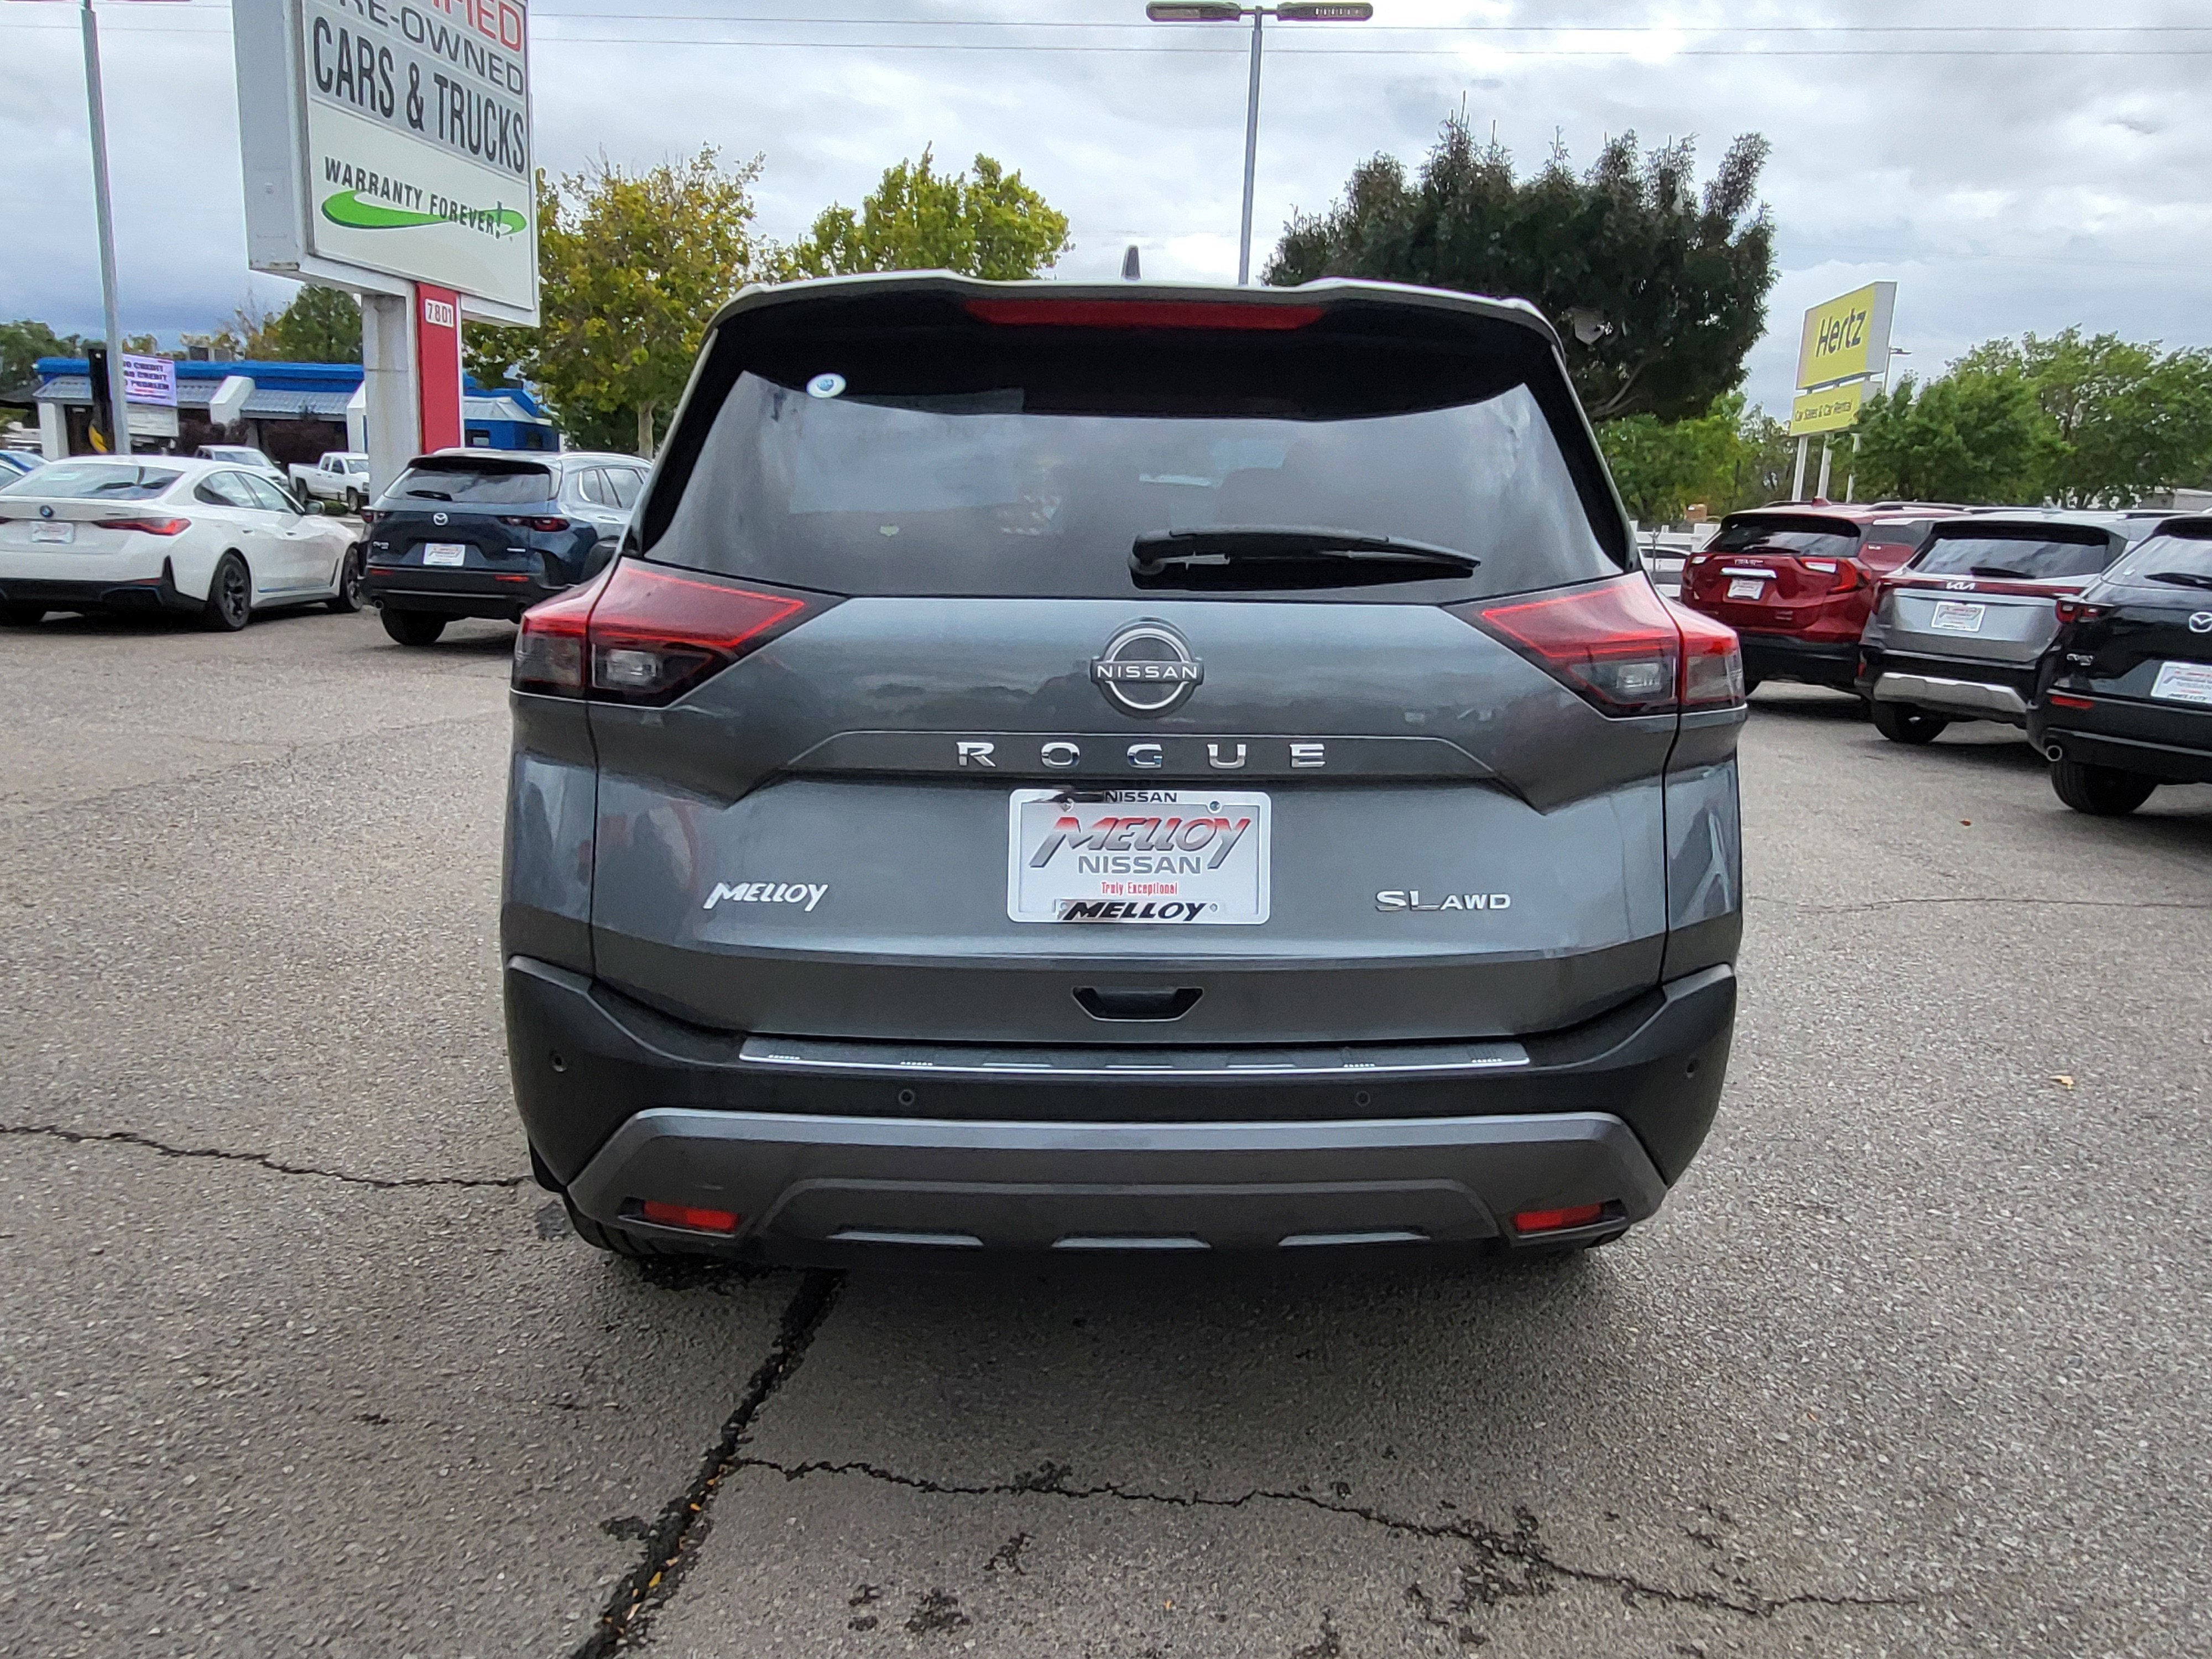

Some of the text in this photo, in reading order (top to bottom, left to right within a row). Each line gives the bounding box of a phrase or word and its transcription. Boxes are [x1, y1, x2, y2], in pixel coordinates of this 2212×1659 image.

[314, 17, 525, 174] CARS & TRUCKS
[325, 156, 423, 210] WARRANTY
[427, 302, 452, 324] 7801
[1815, 307, 1866, 358] Hertz
[1097, 665, 1198, 680] NISSAN
[956, 742, 1326, 769] ROGUE
[1105, 791, 1177, 803] NISSAN
[1029, 816, 1251, 869] MELLOY
[1078, 855, 1201, 874] NISSAN
[702, 882, 828, 912] MELLOY
[1101, 881, 1178, 896] Truly Exceptional
[1063, 901, 1207, 922] MELLOY
[1376, 890, 1511, 911] SL AWD
